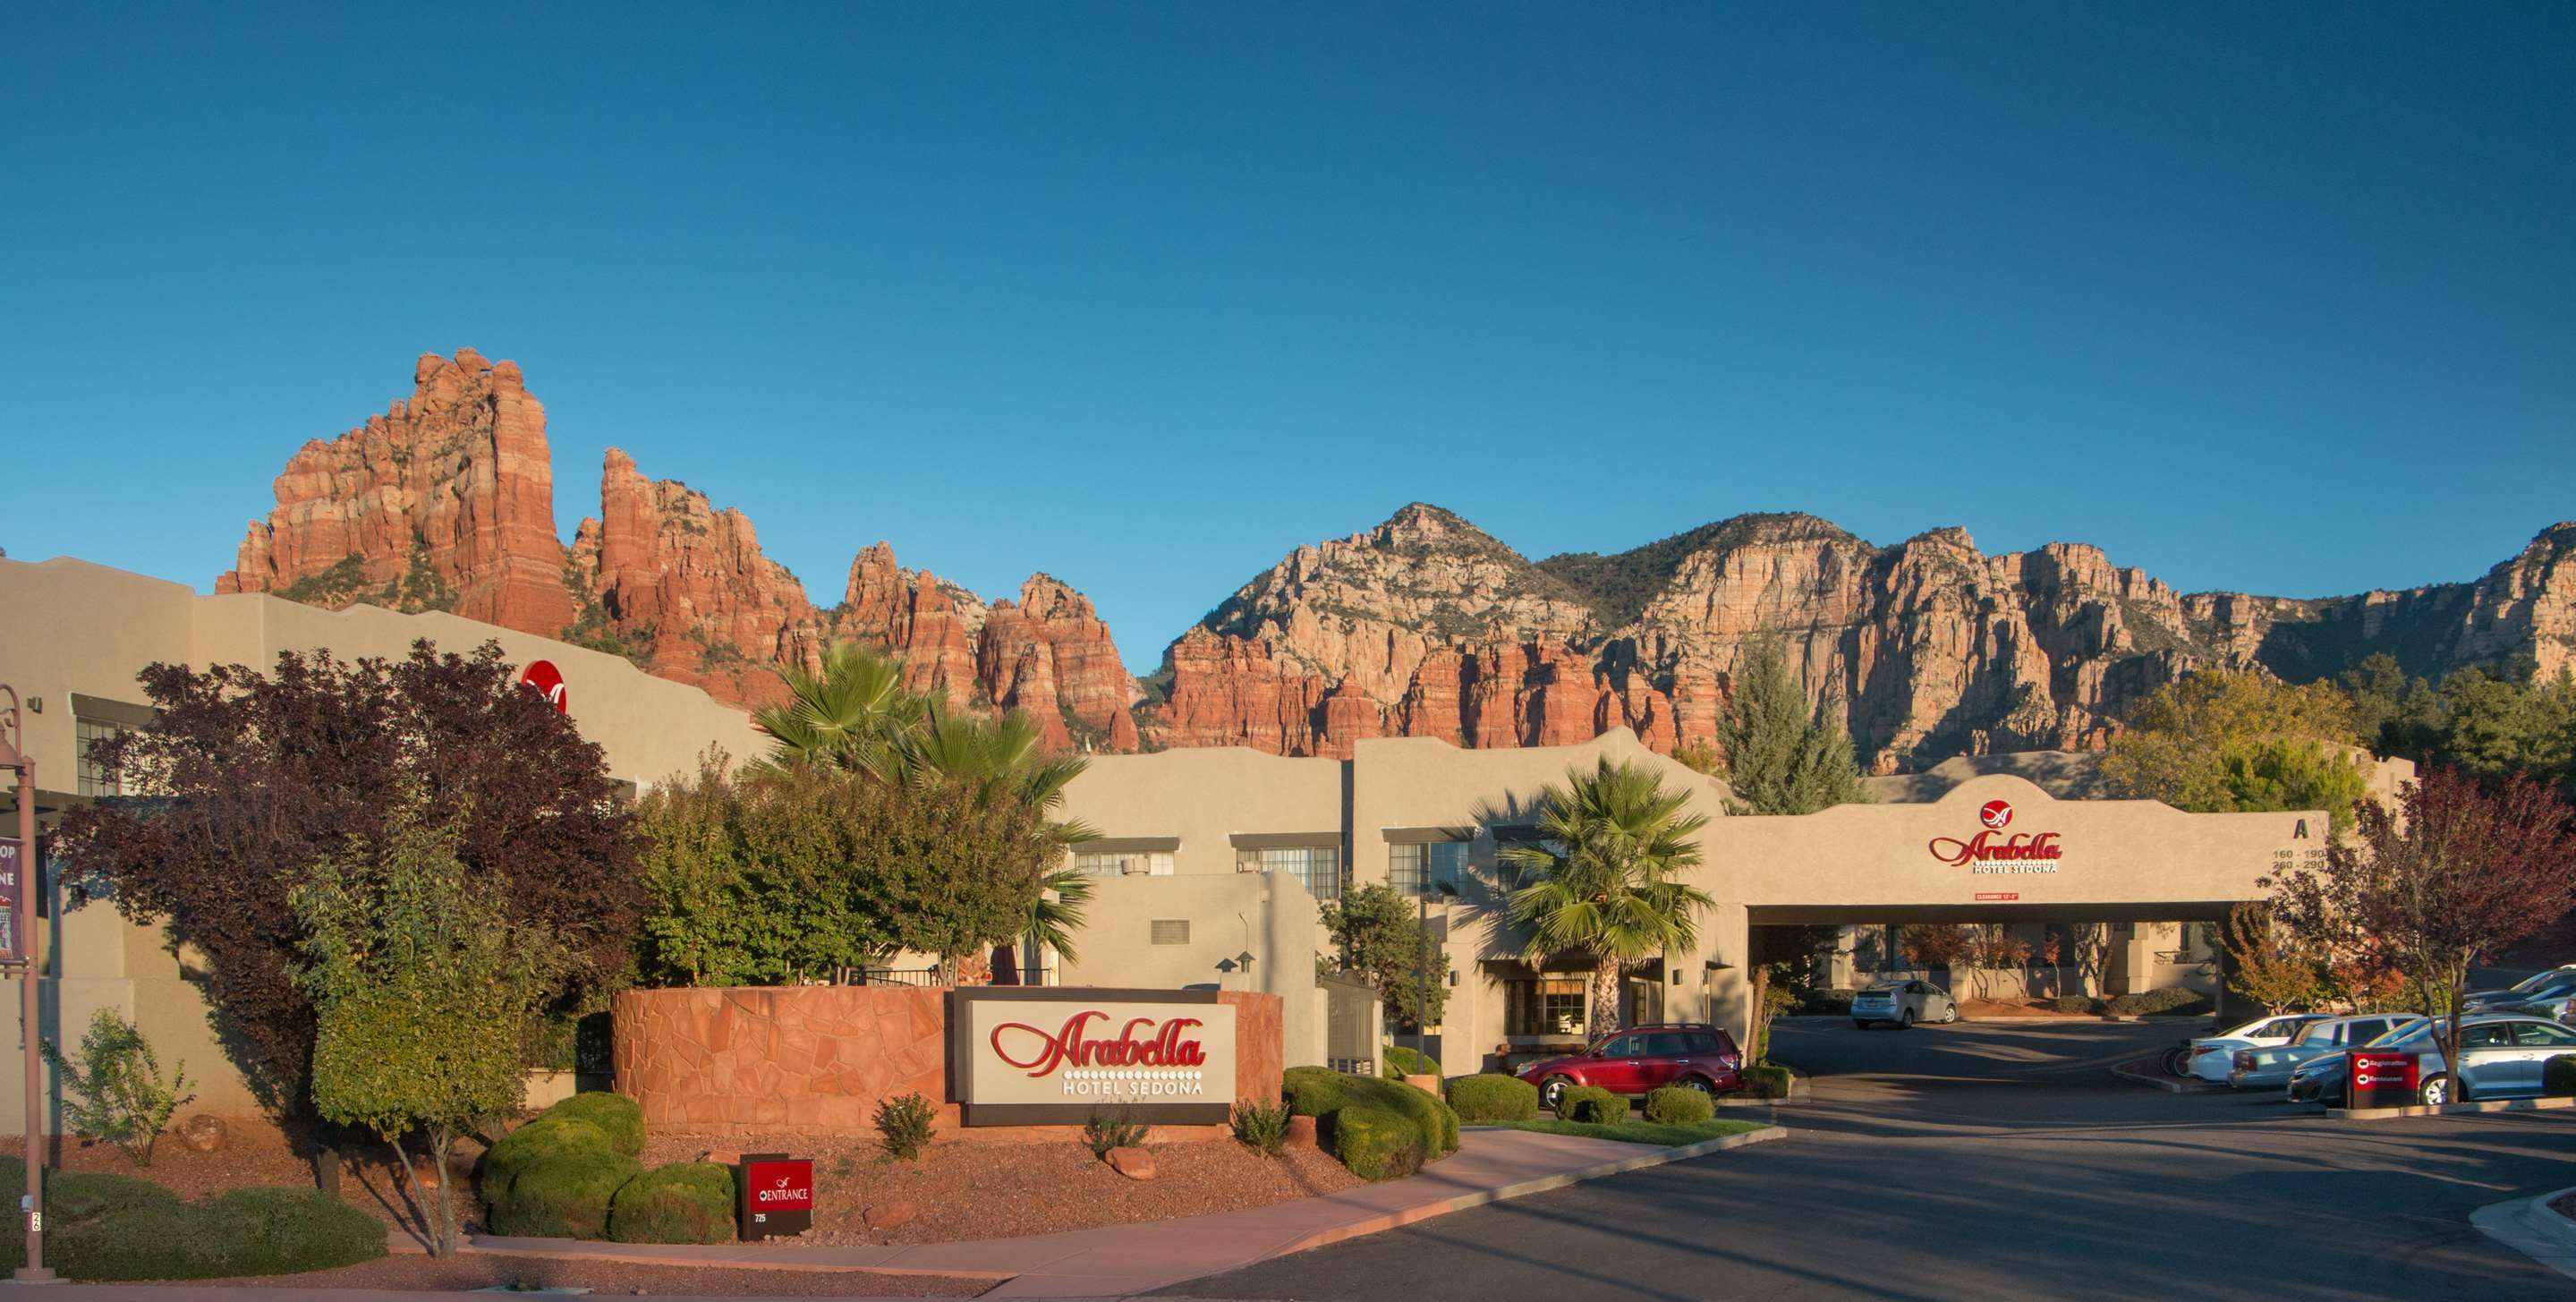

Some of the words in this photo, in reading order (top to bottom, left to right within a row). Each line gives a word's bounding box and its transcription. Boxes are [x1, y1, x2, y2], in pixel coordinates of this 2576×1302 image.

[2292, 818, 2308, 839] A
[1928, 830, 2062, 867] Arabella
[2274, 850, 2293, 858] 160
[2304, 849, 2325, 858] 190
[1973, 865, 2010, 874] HOTEL
[2011, 865, 2059, 873] SEDONA
[2273, 861, 2293, 870] 260
[2303, 860, 2325, 869] 290
[990, 1010, 1207, 1078] Arabella
[1062, 1081, 1122, 1095] HOTEL
[1129, 1081, 1204, 1095] SEDONA
[767, 1188, 809, 1201] ENTRANCE
[33, 1213, 40, 1230] 26
[754, 1213, 767, 1223] 725
